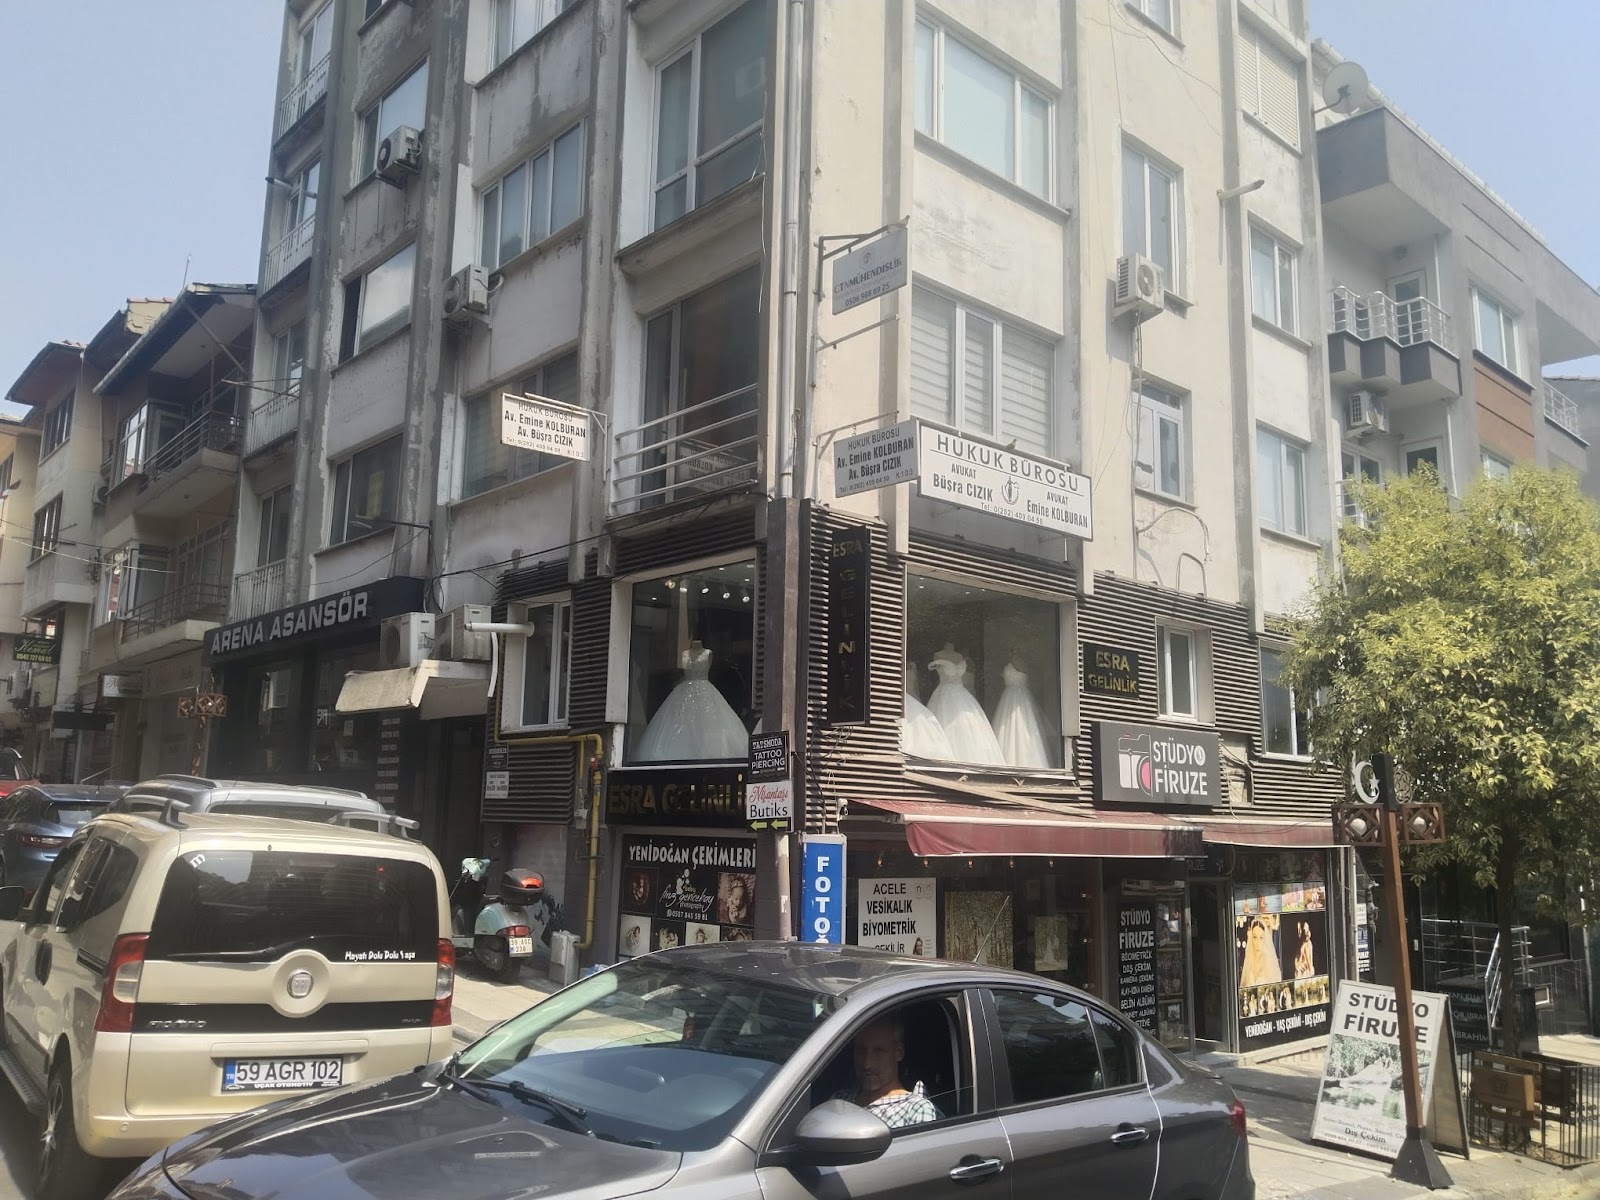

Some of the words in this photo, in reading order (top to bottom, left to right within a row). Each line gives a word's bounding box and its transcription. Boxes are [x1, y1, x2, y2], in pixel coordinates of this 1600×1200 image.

[518, 402, 543, 415] HUKUK
[505, 410, 517, 422] Av.
[519, 413, 543, 428] Emine
[545, 419, 586, 438] KOLBURAN
[517, 426, 529, 438] Av.
[531, 428, 552, 443] Büşra
[554, 434, 573, 448] CIZIK
[848, 437, 870, 450] HUKUK
[872, 427, 900, 444] BÜROSU
[837, 457, 848, 469] Av.
[849, 451, 872, 466] Emine
[873, 437, 914, 459] KOLBURAN
[937, 434, 1003, 470] HUKUK
[1010, 457, 1078, 491] BÜROSU
[848, 468, 859, 480] Av.
[860, 463, 881, 477] Büşra
[882, 456, 902, 471] CIZIK
[951, 463, 977, 480] AVUKAT
[933, 473, 963, 495] Büşra
[966, 482, 994, 503] CIZIK
[1046, 491, 1069, 506] AVUKAT
[980, 502, 992, 511] Tel:
[1027, 499, 1050, 518] Emine
[1051, 506, 1088, 528] KOLBURAN
[832, 539, 863, 558] ESRA
[211, 621, 263, 655] ARENA
[269, 591, 368, 640] ASANSÖR
[1096, 650, 1130, 672] ESRA
[1088, 673, 1137, 693] GELİNLİK
[754, 749, 783, 761] TATTOO
[1153, 737, 1206, 766] STÜDYO
[1154, 764, 1208, 795] FİRUZE
[750, 802, 788, 818] Butiks
[629, 839, 690, 864] YENİDOĞAN
[692, 841, 756, 870] ÇEKİMLERİ
[873, 883, 907, 895] ACELE
[866, 897, 913, 914] VESİKALIK
[863, 917, 917, 936] BİYOMETRİK
[1120, 908, 1151, 926] STÜDYO
[1119, 928, 1155, 949] FİRUZE
[345, 951, 367, 962] Hayatı
[368, 950, 383, 960] Dolu
[384, 950, 399, 960] Dolu
[1120, 997, 1136, 1010] GELİN
[1348, 993, 1429, 1018] STÜDO
[1244, 1020, 1273, 1038] YENİDOĞAN
[1276, 1018, 1286, 1033] YAŞ
[1286, 1013, 1302, 1032] ÇEKİMİ
[1304, 1013, 1313, 1028] DIŞ
[1312, 1009, 1327, 1026] ÇEKİM
[1343, 1012, 1429, 1044] FİRUE
[237, 1062, 260, 1081] 59
[265, 1061, 306, 1080] AGR
[311, 1061, 339, 1080] 102
[1344, 1127, 1358, 1138] Dış
[1360, 1131, 1386, 1144] Çekim
